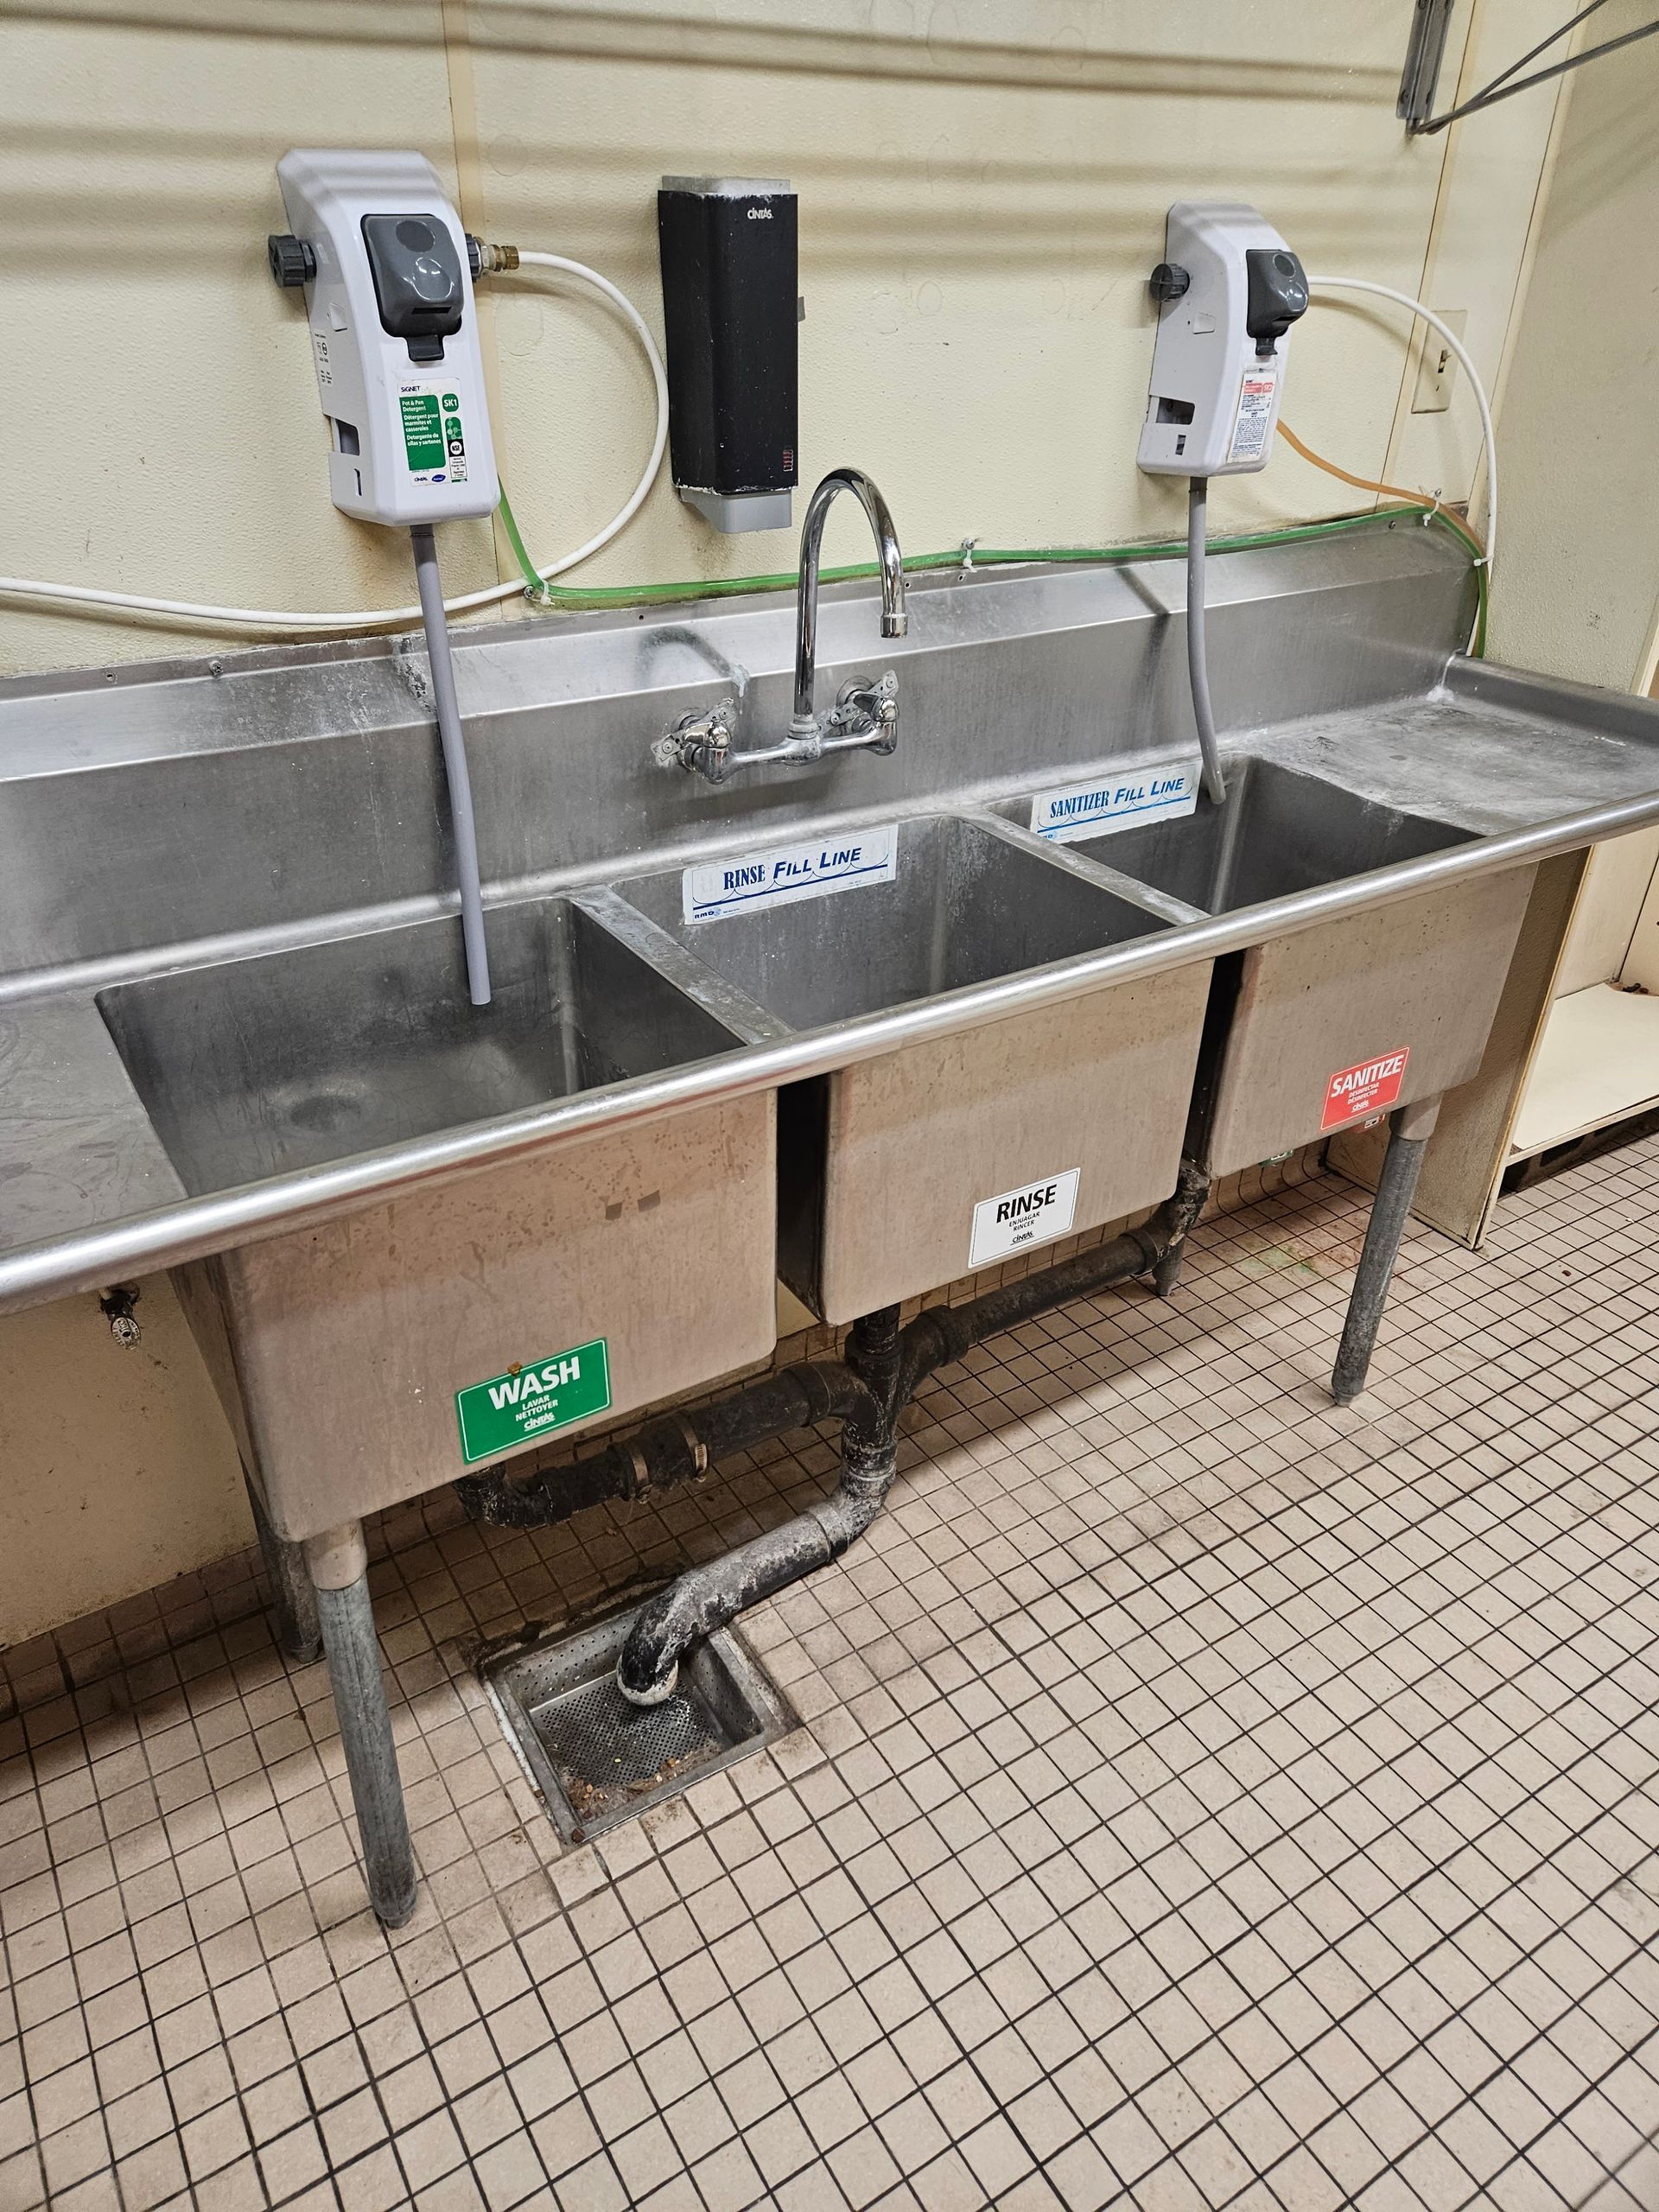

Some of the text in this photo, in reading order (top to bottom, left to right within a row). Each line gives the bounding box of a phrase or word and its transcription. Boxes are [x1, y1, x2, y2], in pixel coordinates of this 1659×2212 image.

[1050, 778, 1185, 818] SANITIZER FILL LINE
[723, 848, 862, 890] RINSE FILL LINE
[695, 911, 715, 919] RMD
[1331, 1054, 1404, 1097] SANITIZE
[996, 1184, 1057, 1224] RINSE
[1009, 1211, 1040, 1227] ENJUAGAR
[1013, 1220, 1035, 1232] RINCER
[488, 1357, 581, 1410] WASH
[515, 1400, 558, 1421] NETTOYER
[522, 1395, 550, 1410] LAVAR
